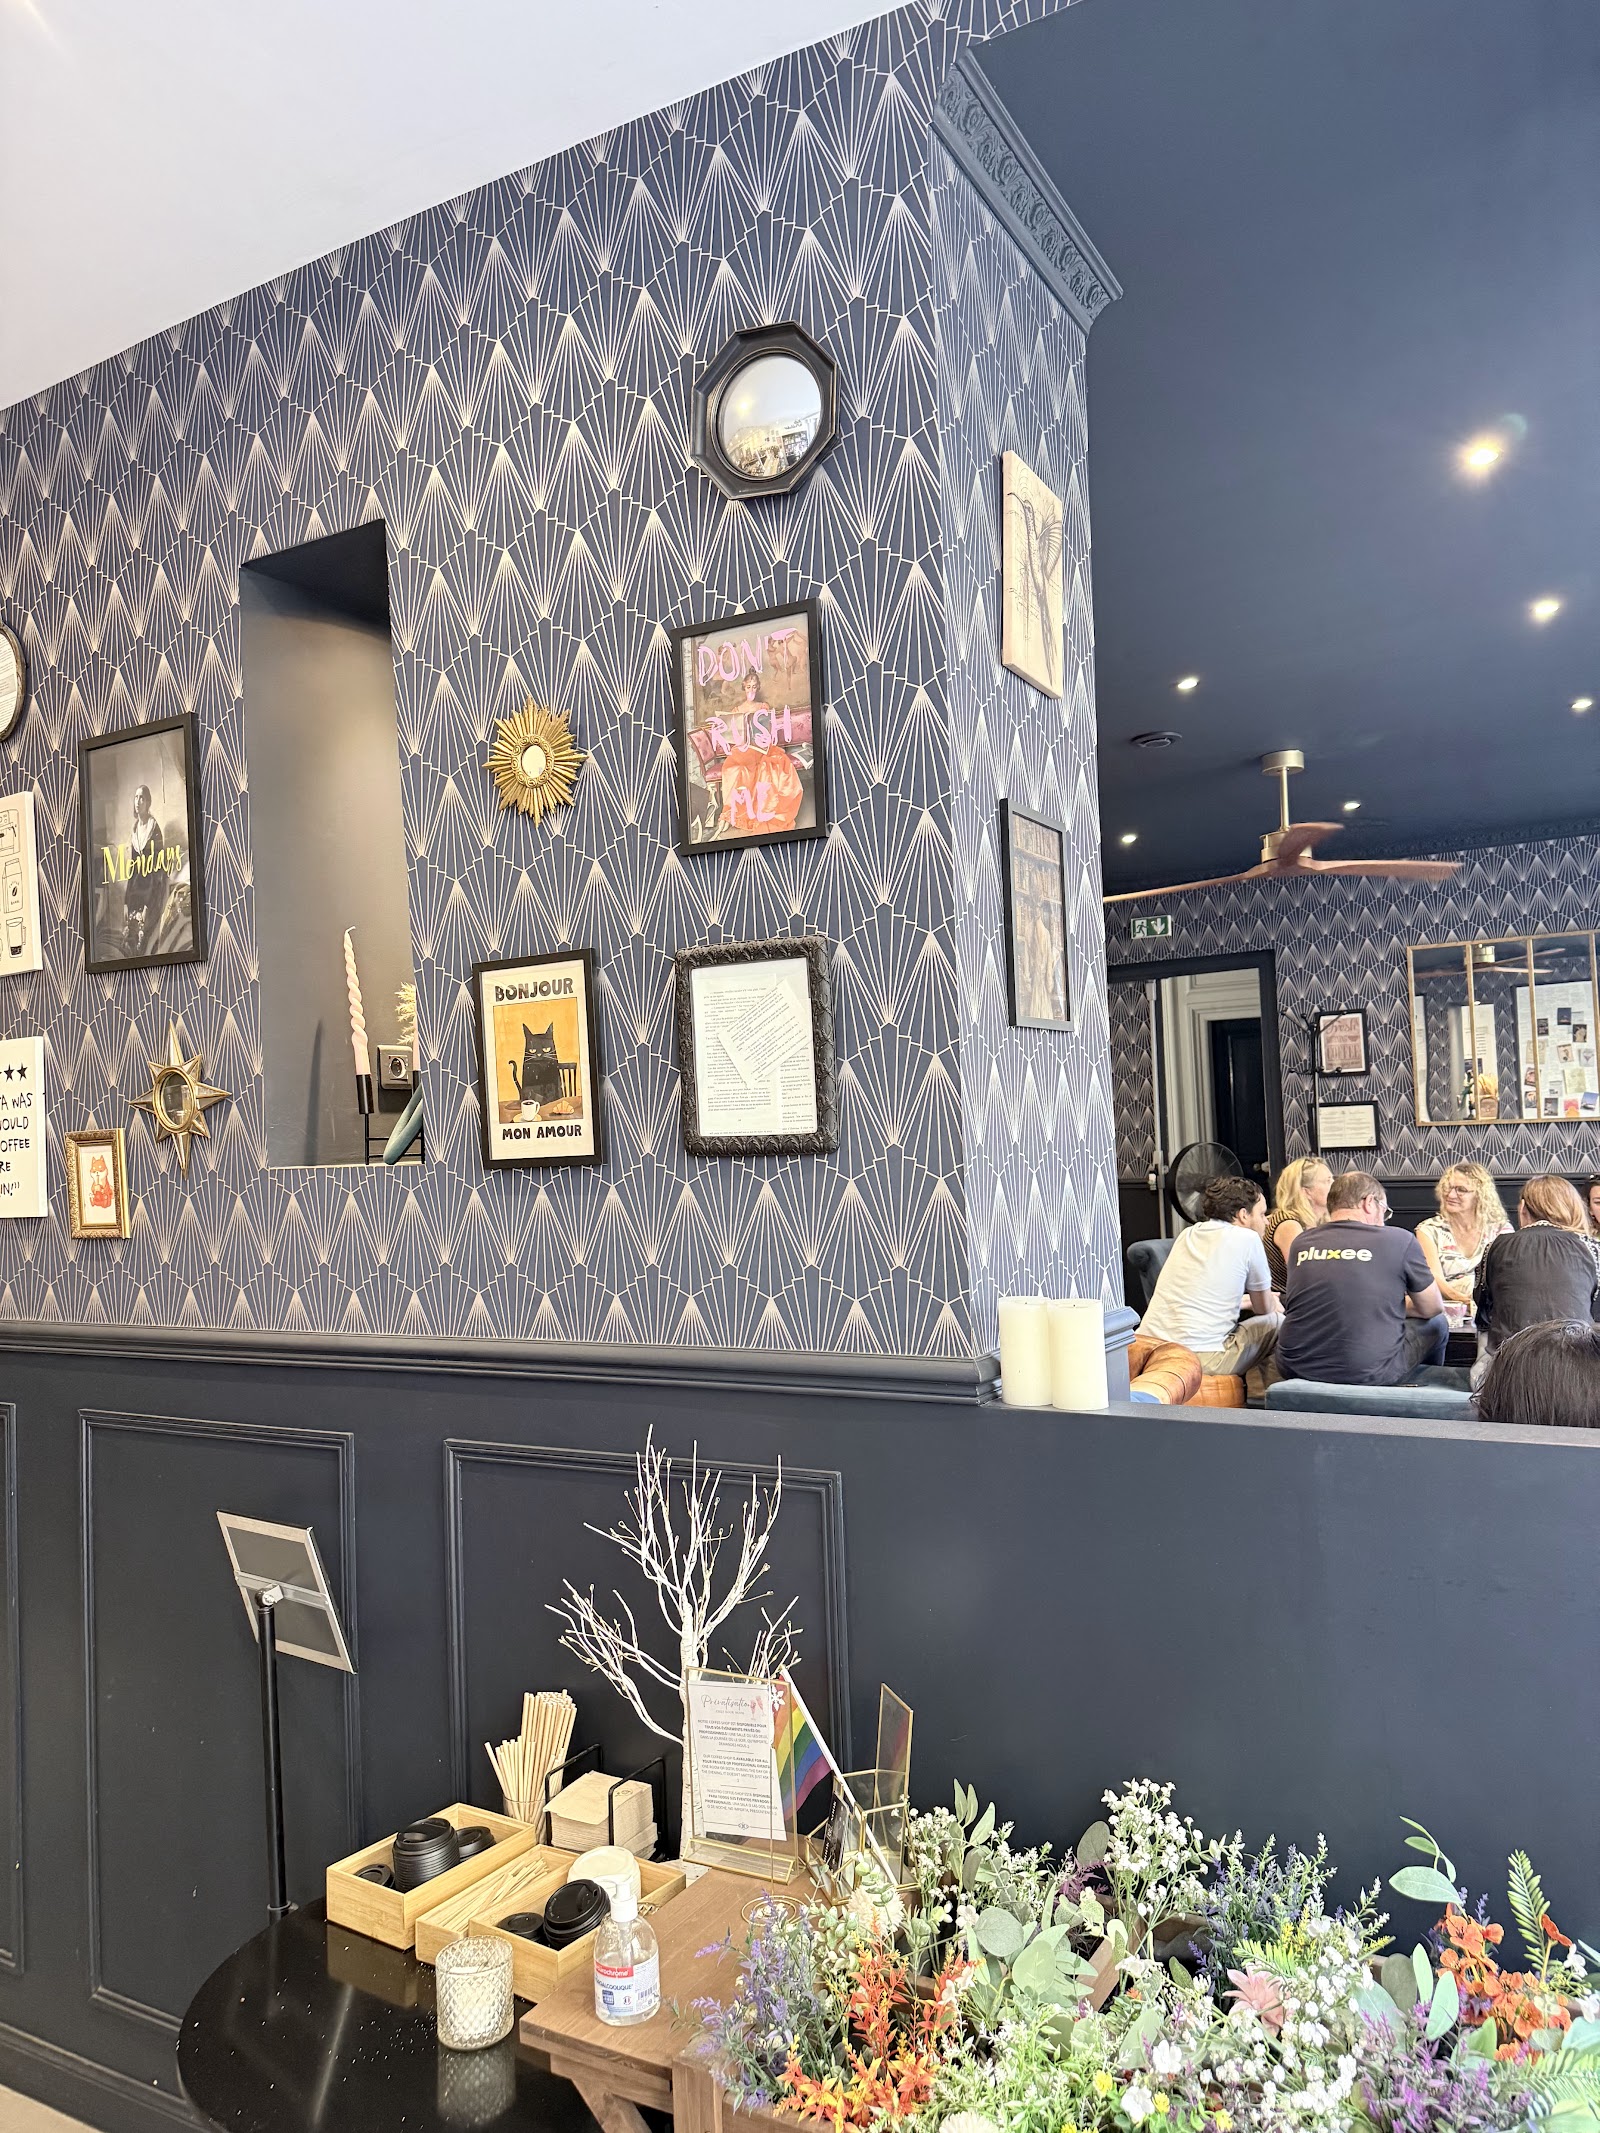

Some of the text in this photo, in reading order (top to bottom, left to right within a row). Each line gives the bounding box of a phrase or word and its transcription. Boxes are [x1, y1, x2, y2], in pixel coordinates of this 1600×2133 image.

[698, 627, 798, 686] DON'T
[705, 705, 792, 755] RUSH
[730, 781, 775, 826] ME
[101, 840, 185, 884] Mondays
[495, 977, 574, 1002] BONJOUR
[12, 1092, 33, 1109] WAS
[0, 1116, 29, 1131] OULD
[502, 1124, 582, 1141] MON AMOUR
[0, 1138, 30, 1153] OFFEE
[1296, 1246, 1373, 1267] pluxee
